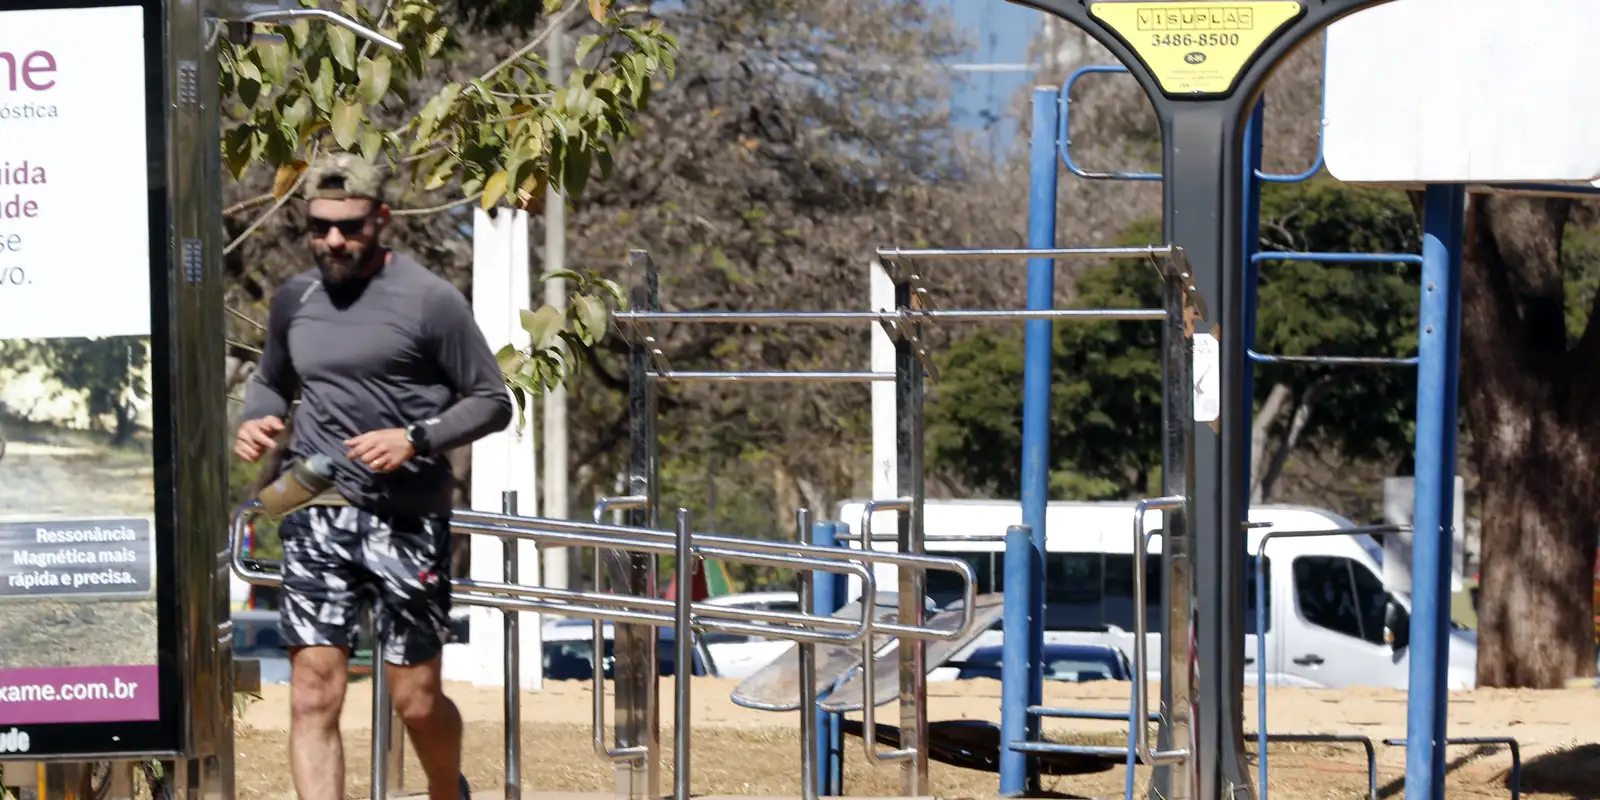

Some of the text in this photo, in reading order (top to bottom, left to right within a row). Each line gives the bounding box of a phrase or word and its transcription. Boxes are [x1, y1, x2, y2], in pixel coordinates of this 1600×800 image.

[1138, 12, 1251, 27] VISUPLAC
[1151, 33, 1240, 47] 3486-8500
[0, 160, 47, 185] ida
[0, 193, 39, 218] de
[36, 525, 136, 543] Ressonância
[13, 547, 136, 567] Magnética mais
[8, 568, 137, 589] rápida e precisa.
